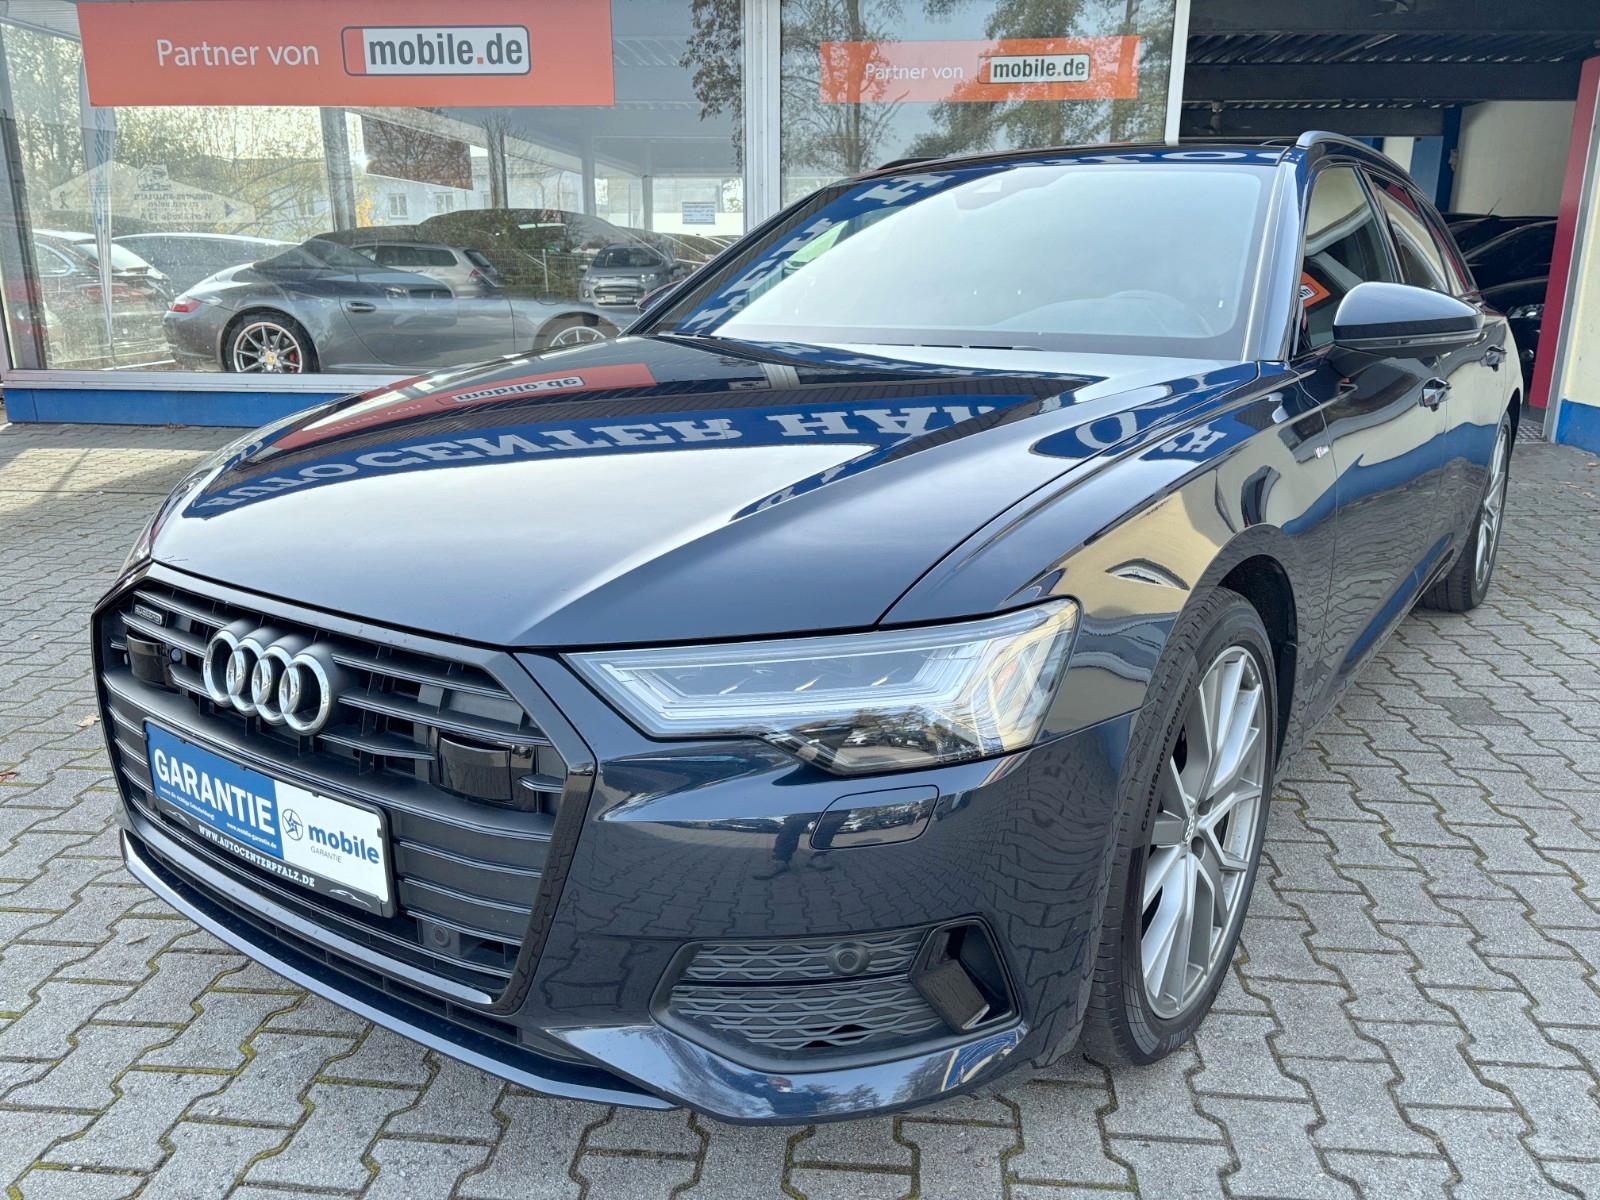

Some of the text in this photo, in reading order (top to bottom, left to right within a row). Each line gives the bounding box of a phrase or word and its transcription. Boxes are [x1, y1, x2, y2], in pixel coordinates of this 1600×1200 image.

[156, 32, 524, 68] Partner von mobile.de
[864, 57, 1086, 81] Partner von mobile.de
[154, 748, 276, 836] GARANTIE
[198, 824, 316, 888] WWW.AUTOCENTERPFALZ.DE
[308, 824, 380, 865] mobile
[310, 845, 343, 865] GARANTIE
